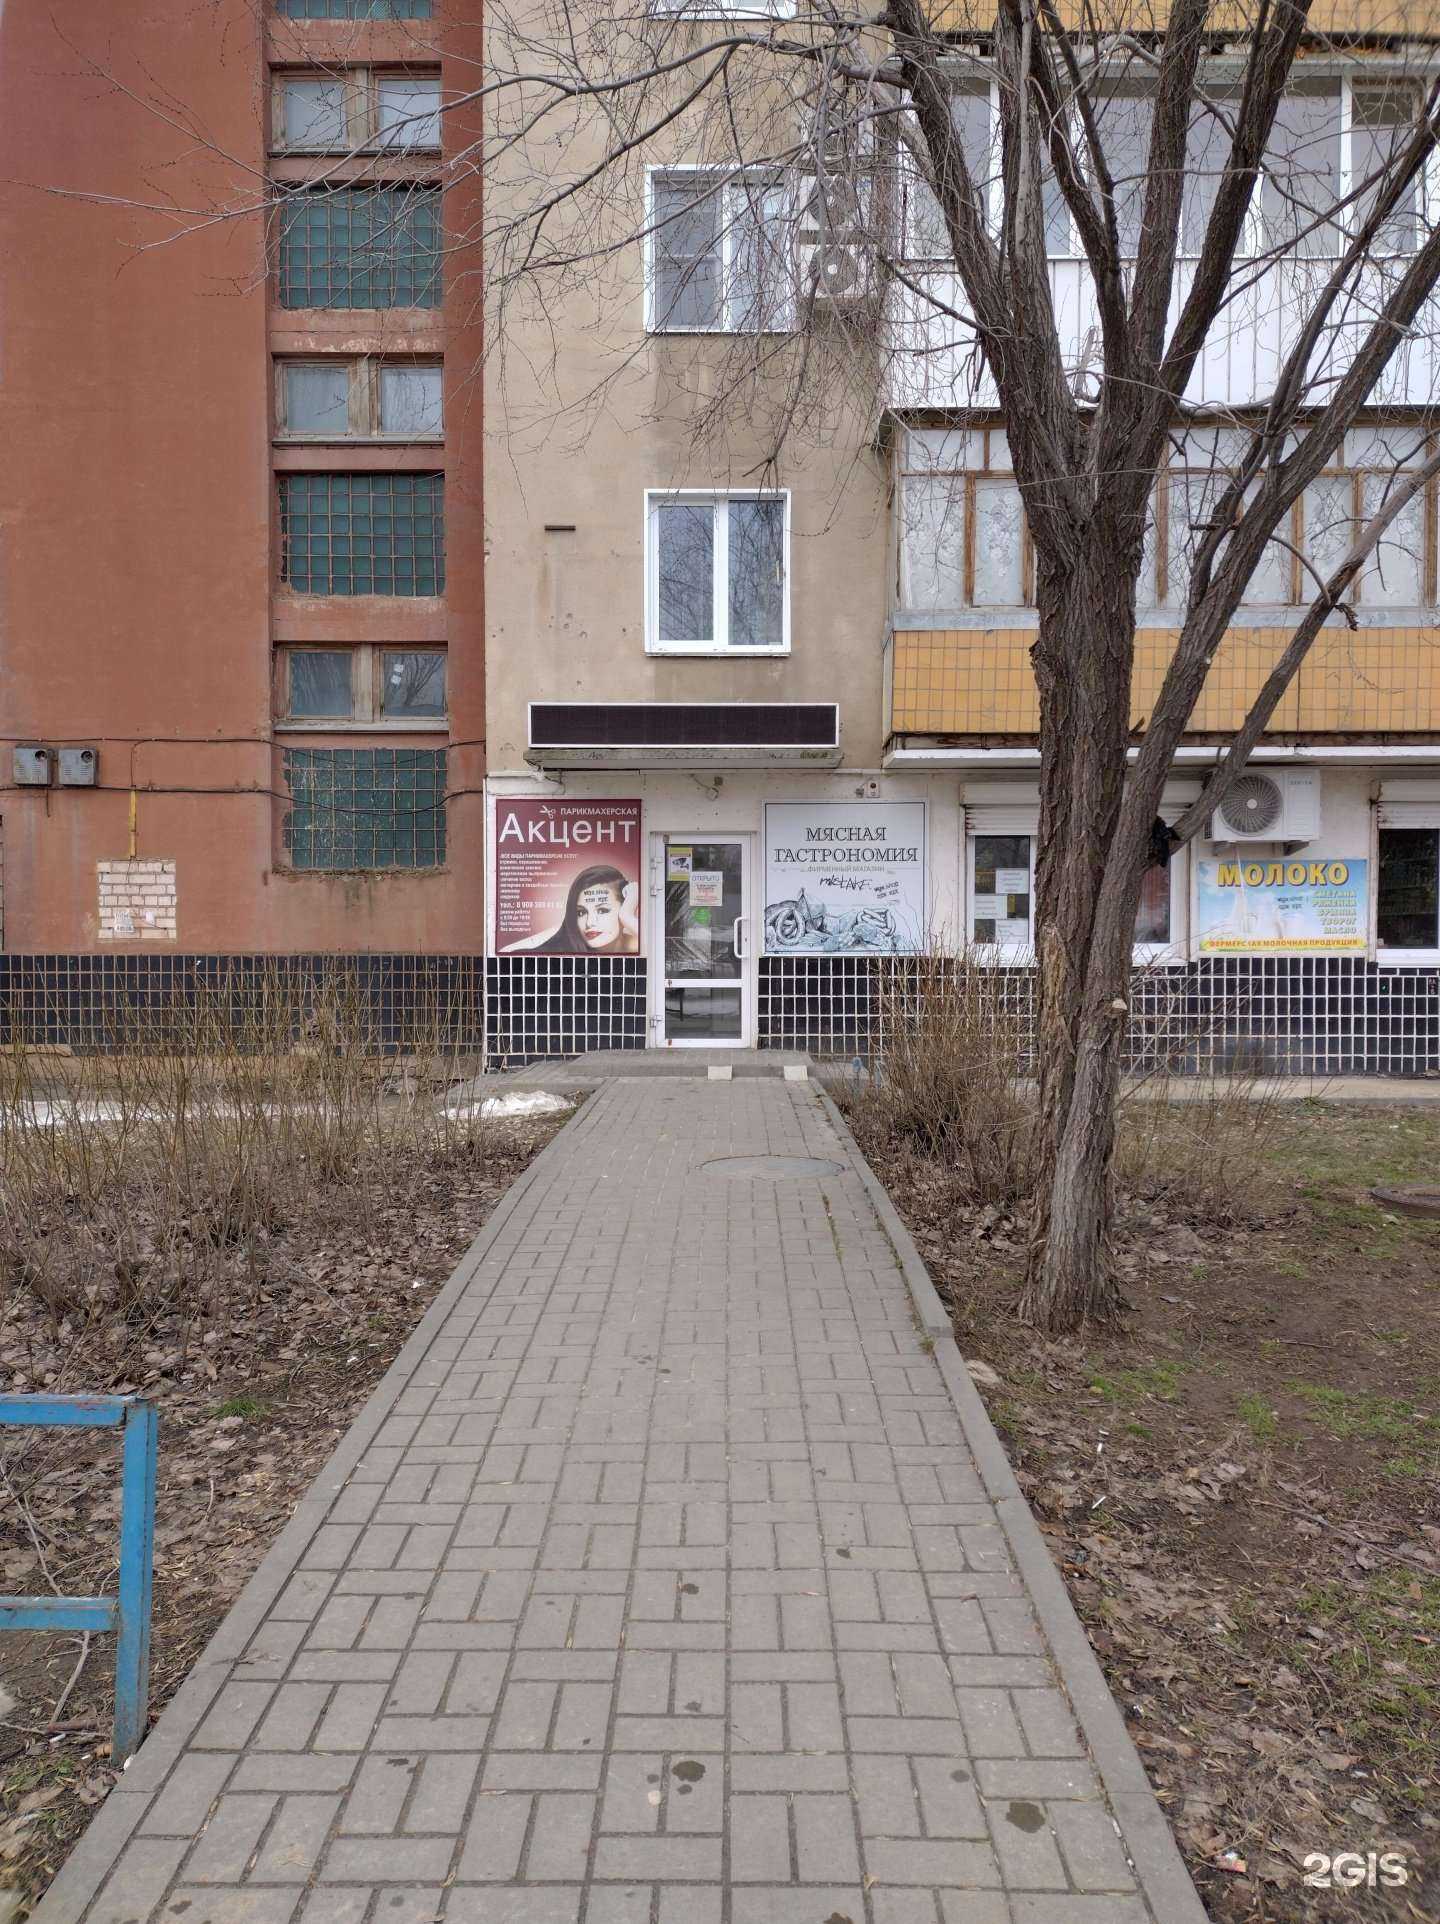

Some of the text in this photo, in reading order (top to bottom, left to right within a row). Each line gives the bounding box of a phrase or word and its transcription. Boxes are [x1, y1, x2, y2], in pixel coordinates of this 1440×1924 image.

[560, 807, 638, 816] ПАРИКМАХЕРСКАЯ
[498, 812, 636, 848] Акцент
[805, 826, 887, 842] МЯСНАЯ
[774, 847, 919, 863] ГАСТРОНОМИЯ
[1217, 862, 1350, 888] МОЛОКО
[1263, 939, 1308, 947] МОЛОЧНАЯ
[1309, 938, 1358, 946] ПРОДУКЦИЯ
